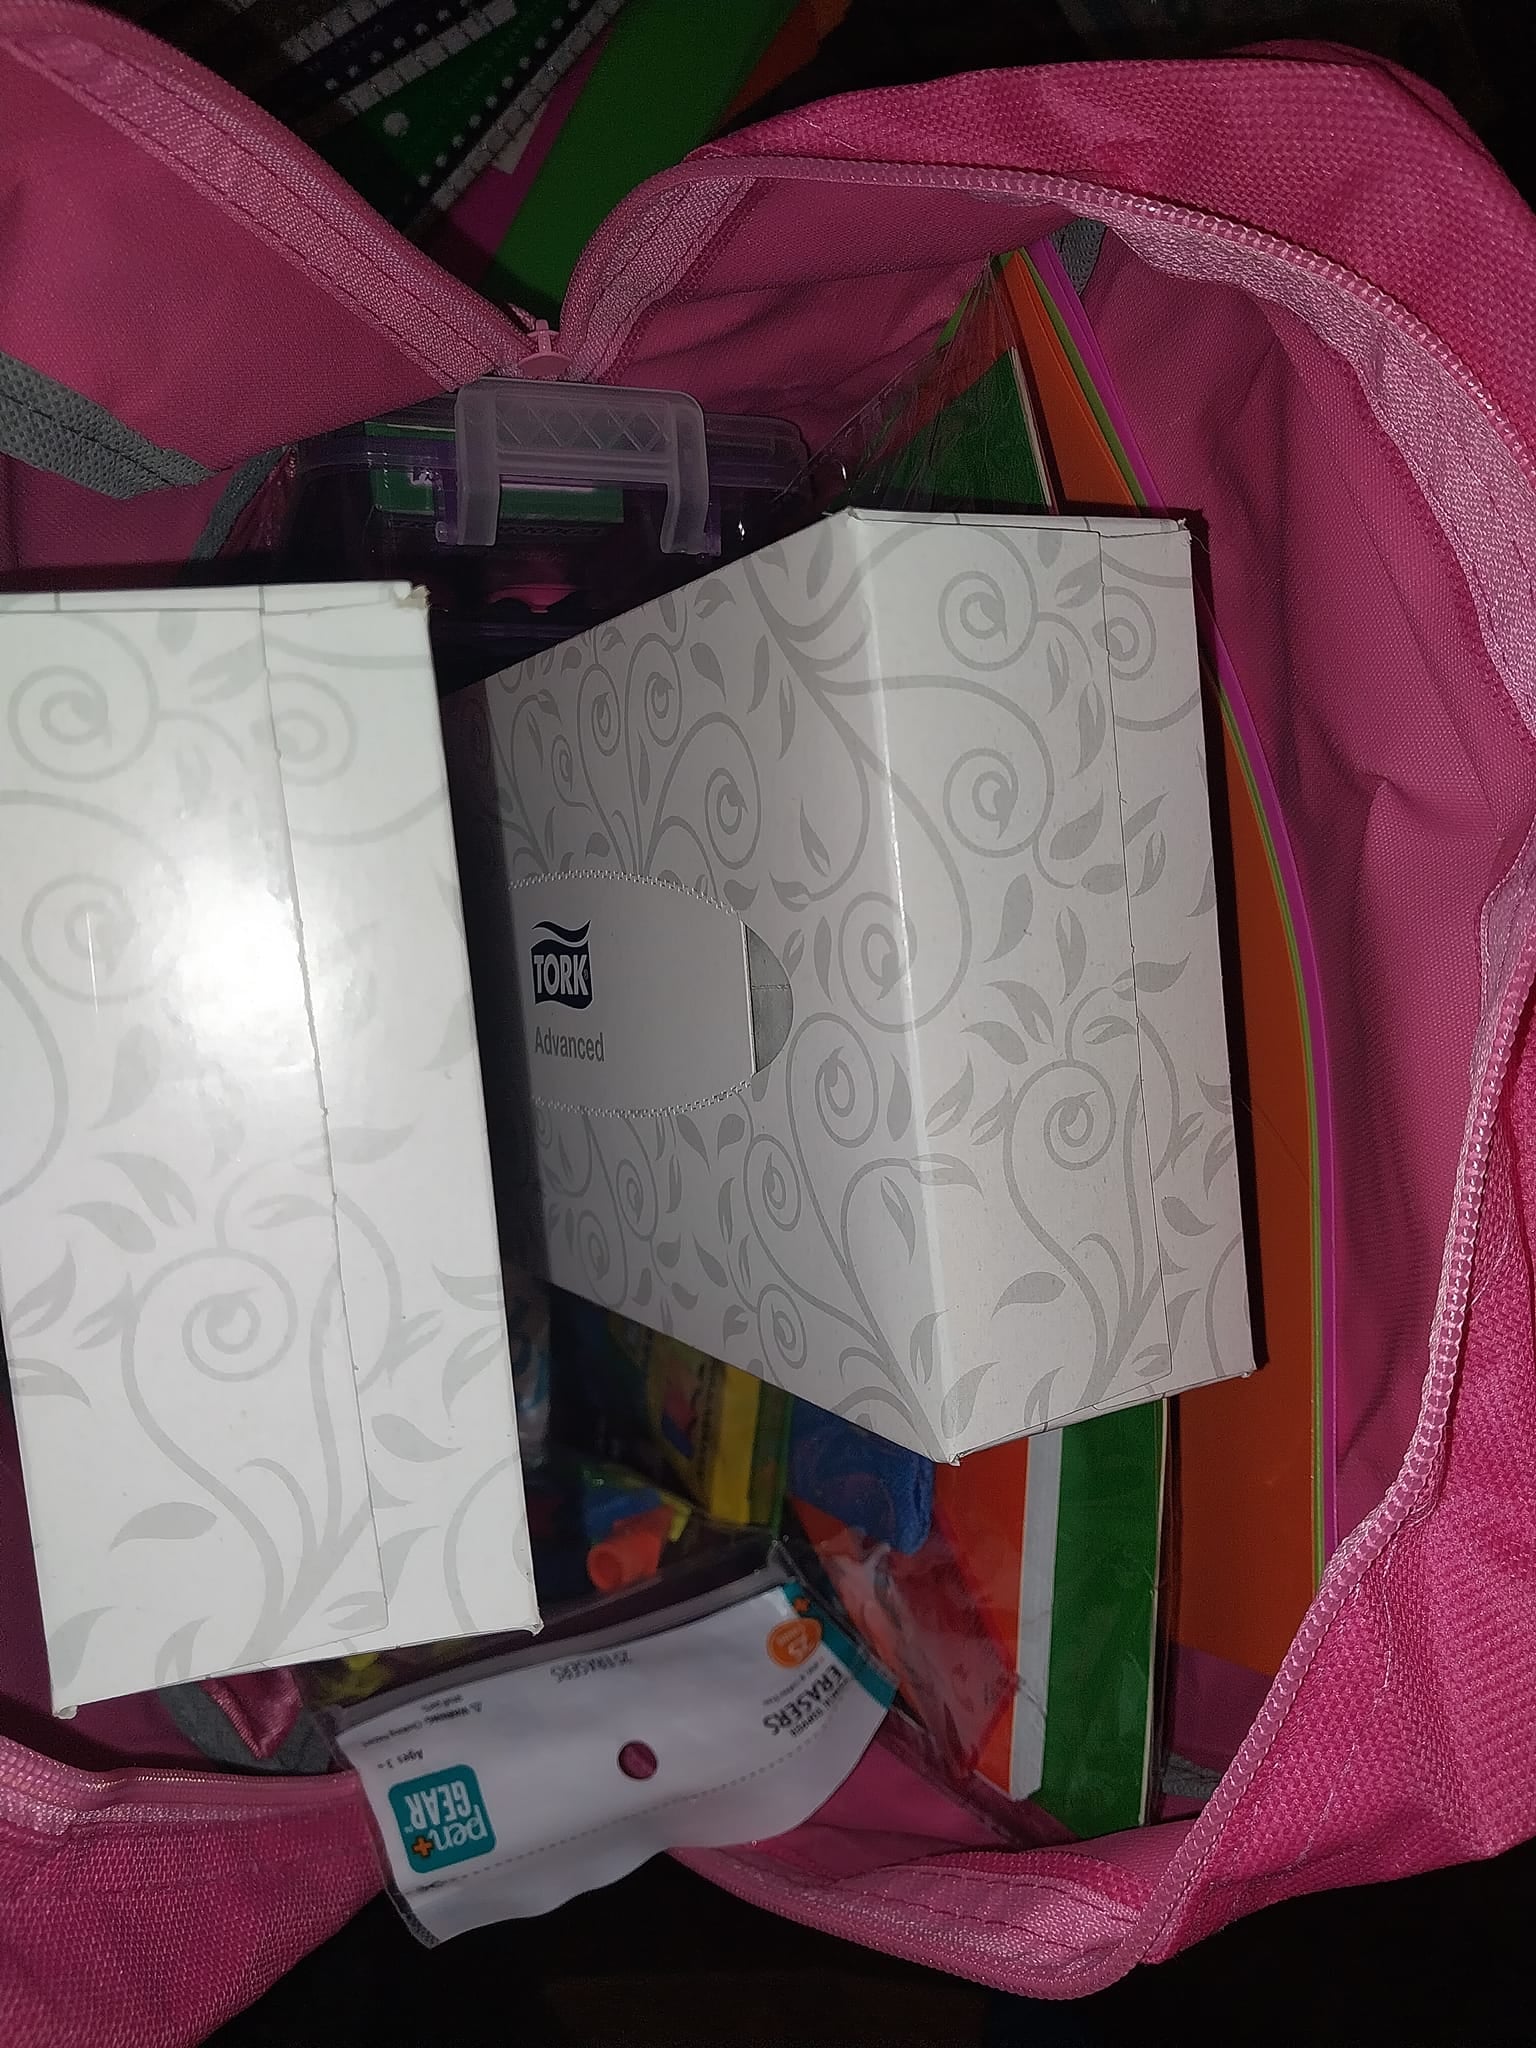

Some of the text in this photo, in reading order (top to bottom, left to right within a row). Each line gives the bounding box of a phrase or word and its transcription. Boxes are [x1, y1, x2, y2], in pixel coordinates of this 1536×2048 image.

[534, 954, 589, 996] TORK
[535, 1026, 605, 1062] Advanced
[763, 1664, 843, 1736] ERASERS
[397, 1749, 424, 1764] Ages
[404, 1780, 470, 1830] GEAR
